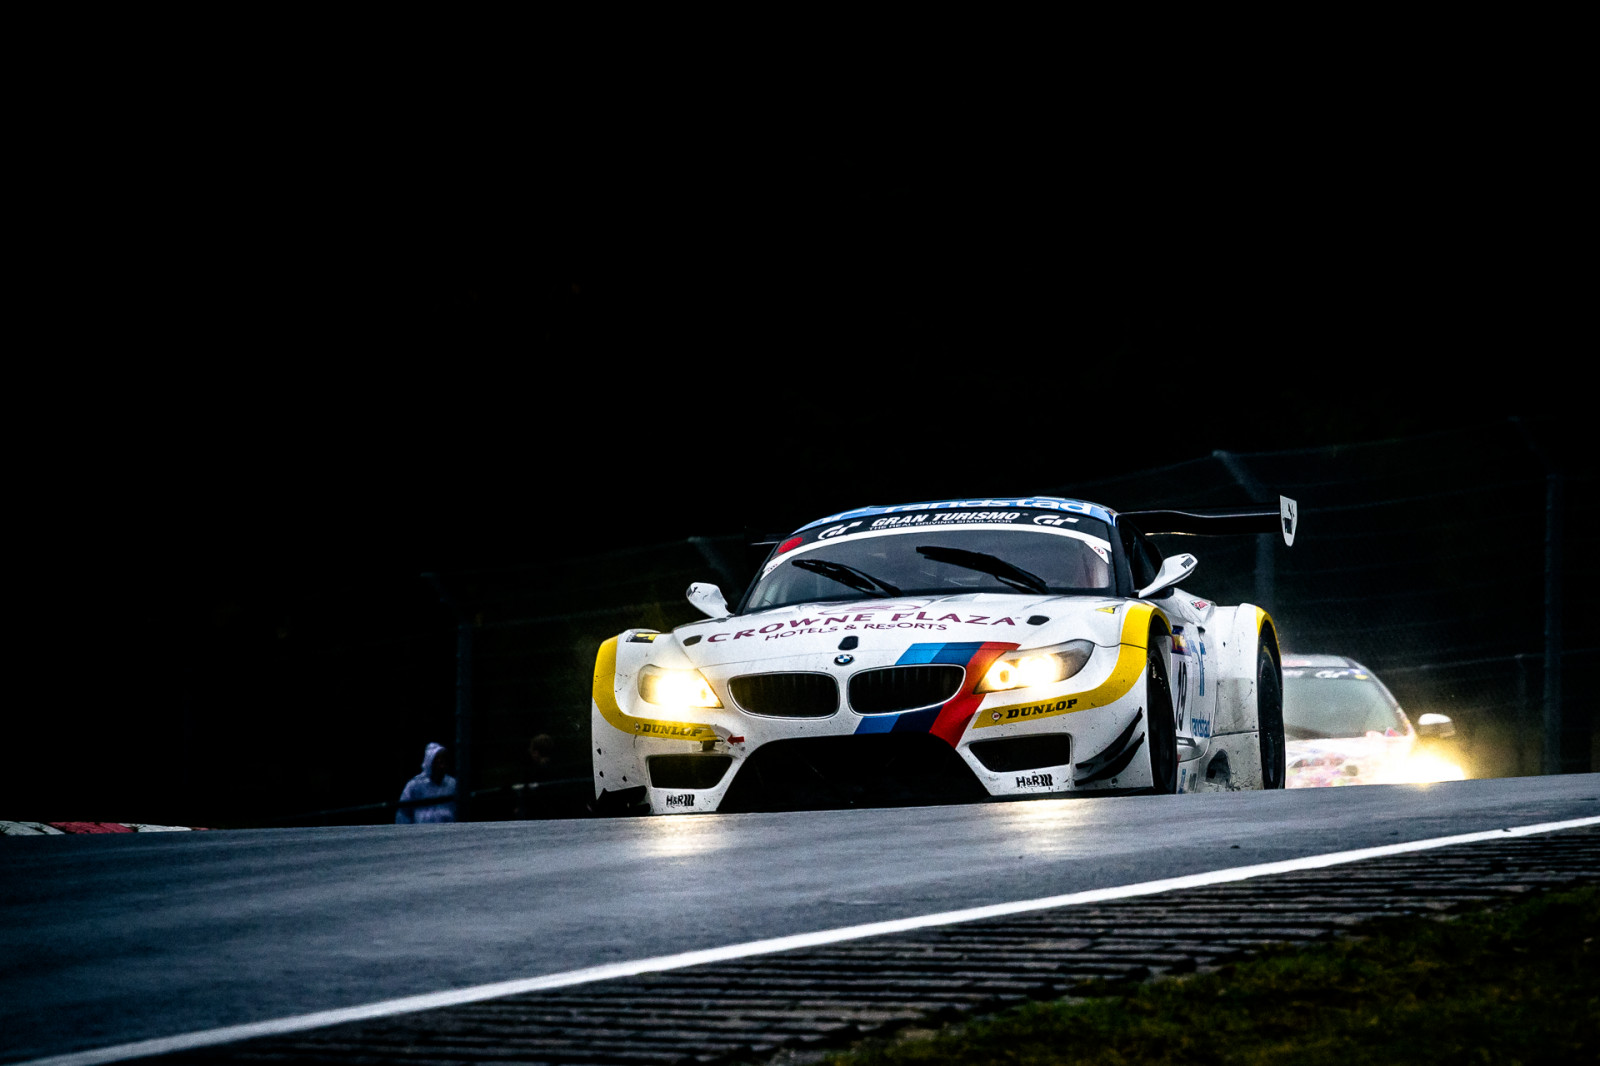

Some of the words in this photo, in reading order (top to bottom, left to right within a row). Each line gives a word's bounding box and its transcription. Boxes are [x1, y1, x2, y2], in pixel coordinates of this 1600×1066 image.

[872, 514, 929, 528] GRAN
[933, 511, 1020, 523] TURISMO
[707, 613, 872, 643] CROWNE
[891, 611, 1016, 627] PLAZA
[765, 625, 837, 640] HOTELS
[864, 621, 948, 631] RESORTS
[1006, 699, 1077, 718] DUNLOP
[642, 724, 703, 736] DUNLOP
[1016, 774, 1042, 788] H&R
[666, 794, 687, 807] H&R
